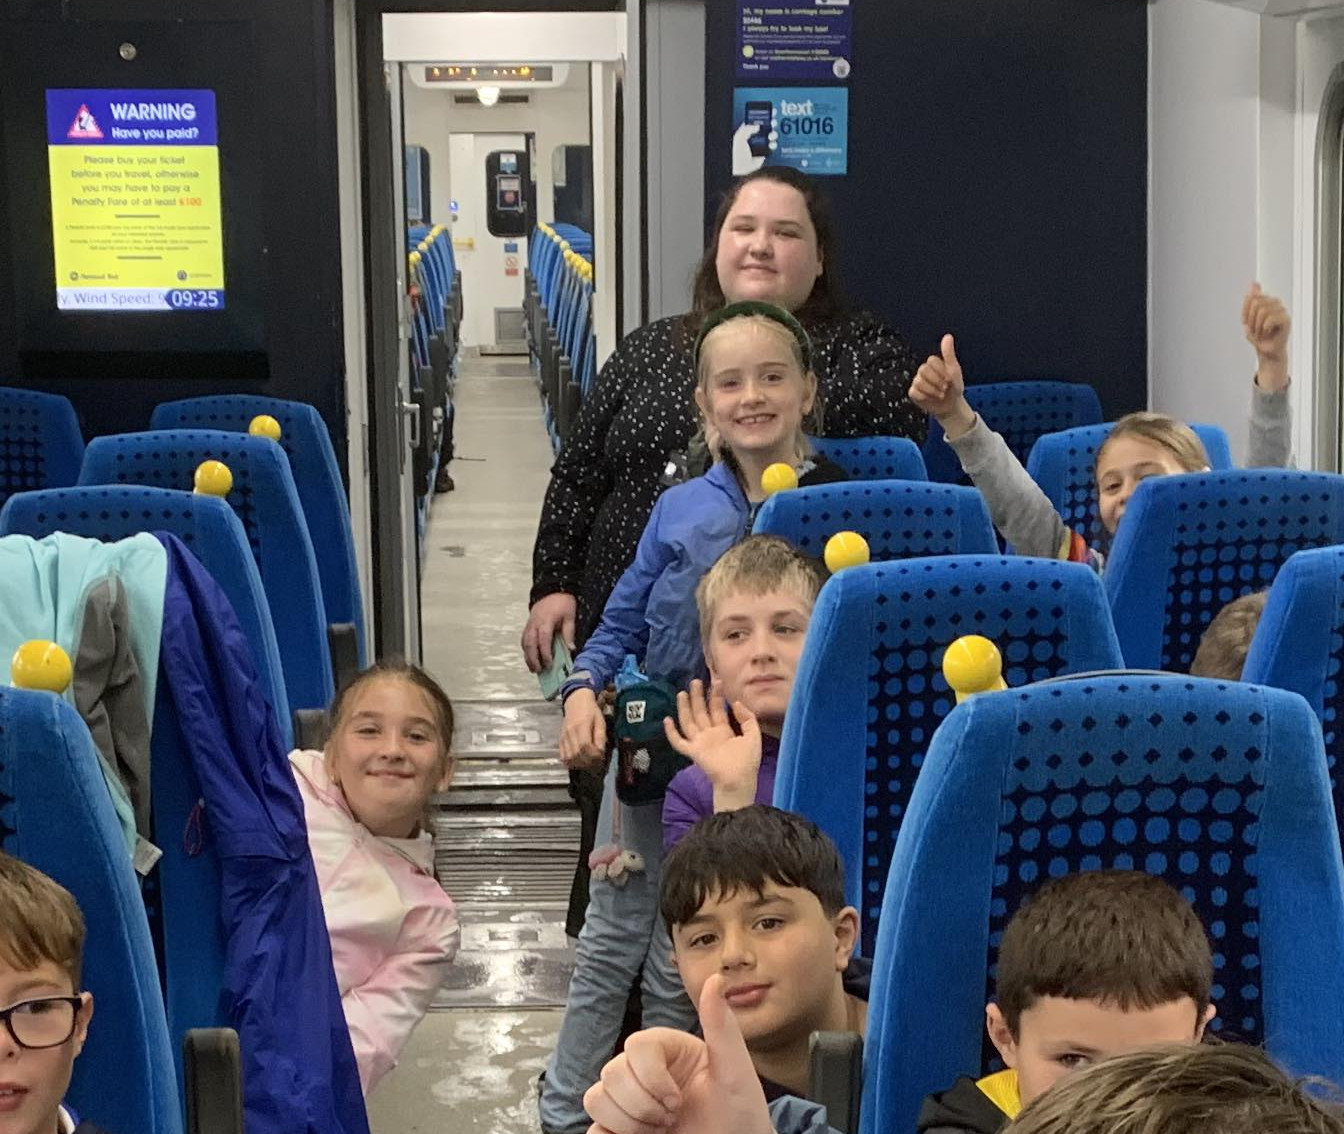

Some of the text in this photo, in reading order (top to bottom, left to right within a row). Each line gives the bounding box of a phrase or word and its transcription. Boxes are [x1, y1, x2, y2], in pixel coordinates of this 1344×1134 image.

[109, 102, 196, 121] WARNING
[780, 99, 815, 117] text
[780, 116, 834, 135] 61016
[111, 127, 199, 140] Have you paid?
[116, 155, 134, 166] buy
[104, 171, 122, 180] you
[81, 185, 99, 193] you
[102, 185, 122, 193] may
[125, 184, 148, 192] have
[151, 184, 160, 192] to
[163, 185, 181, 193] pay
[74, 292, 106, 304] Wind
[171, 290, 219, 308] 09:25
